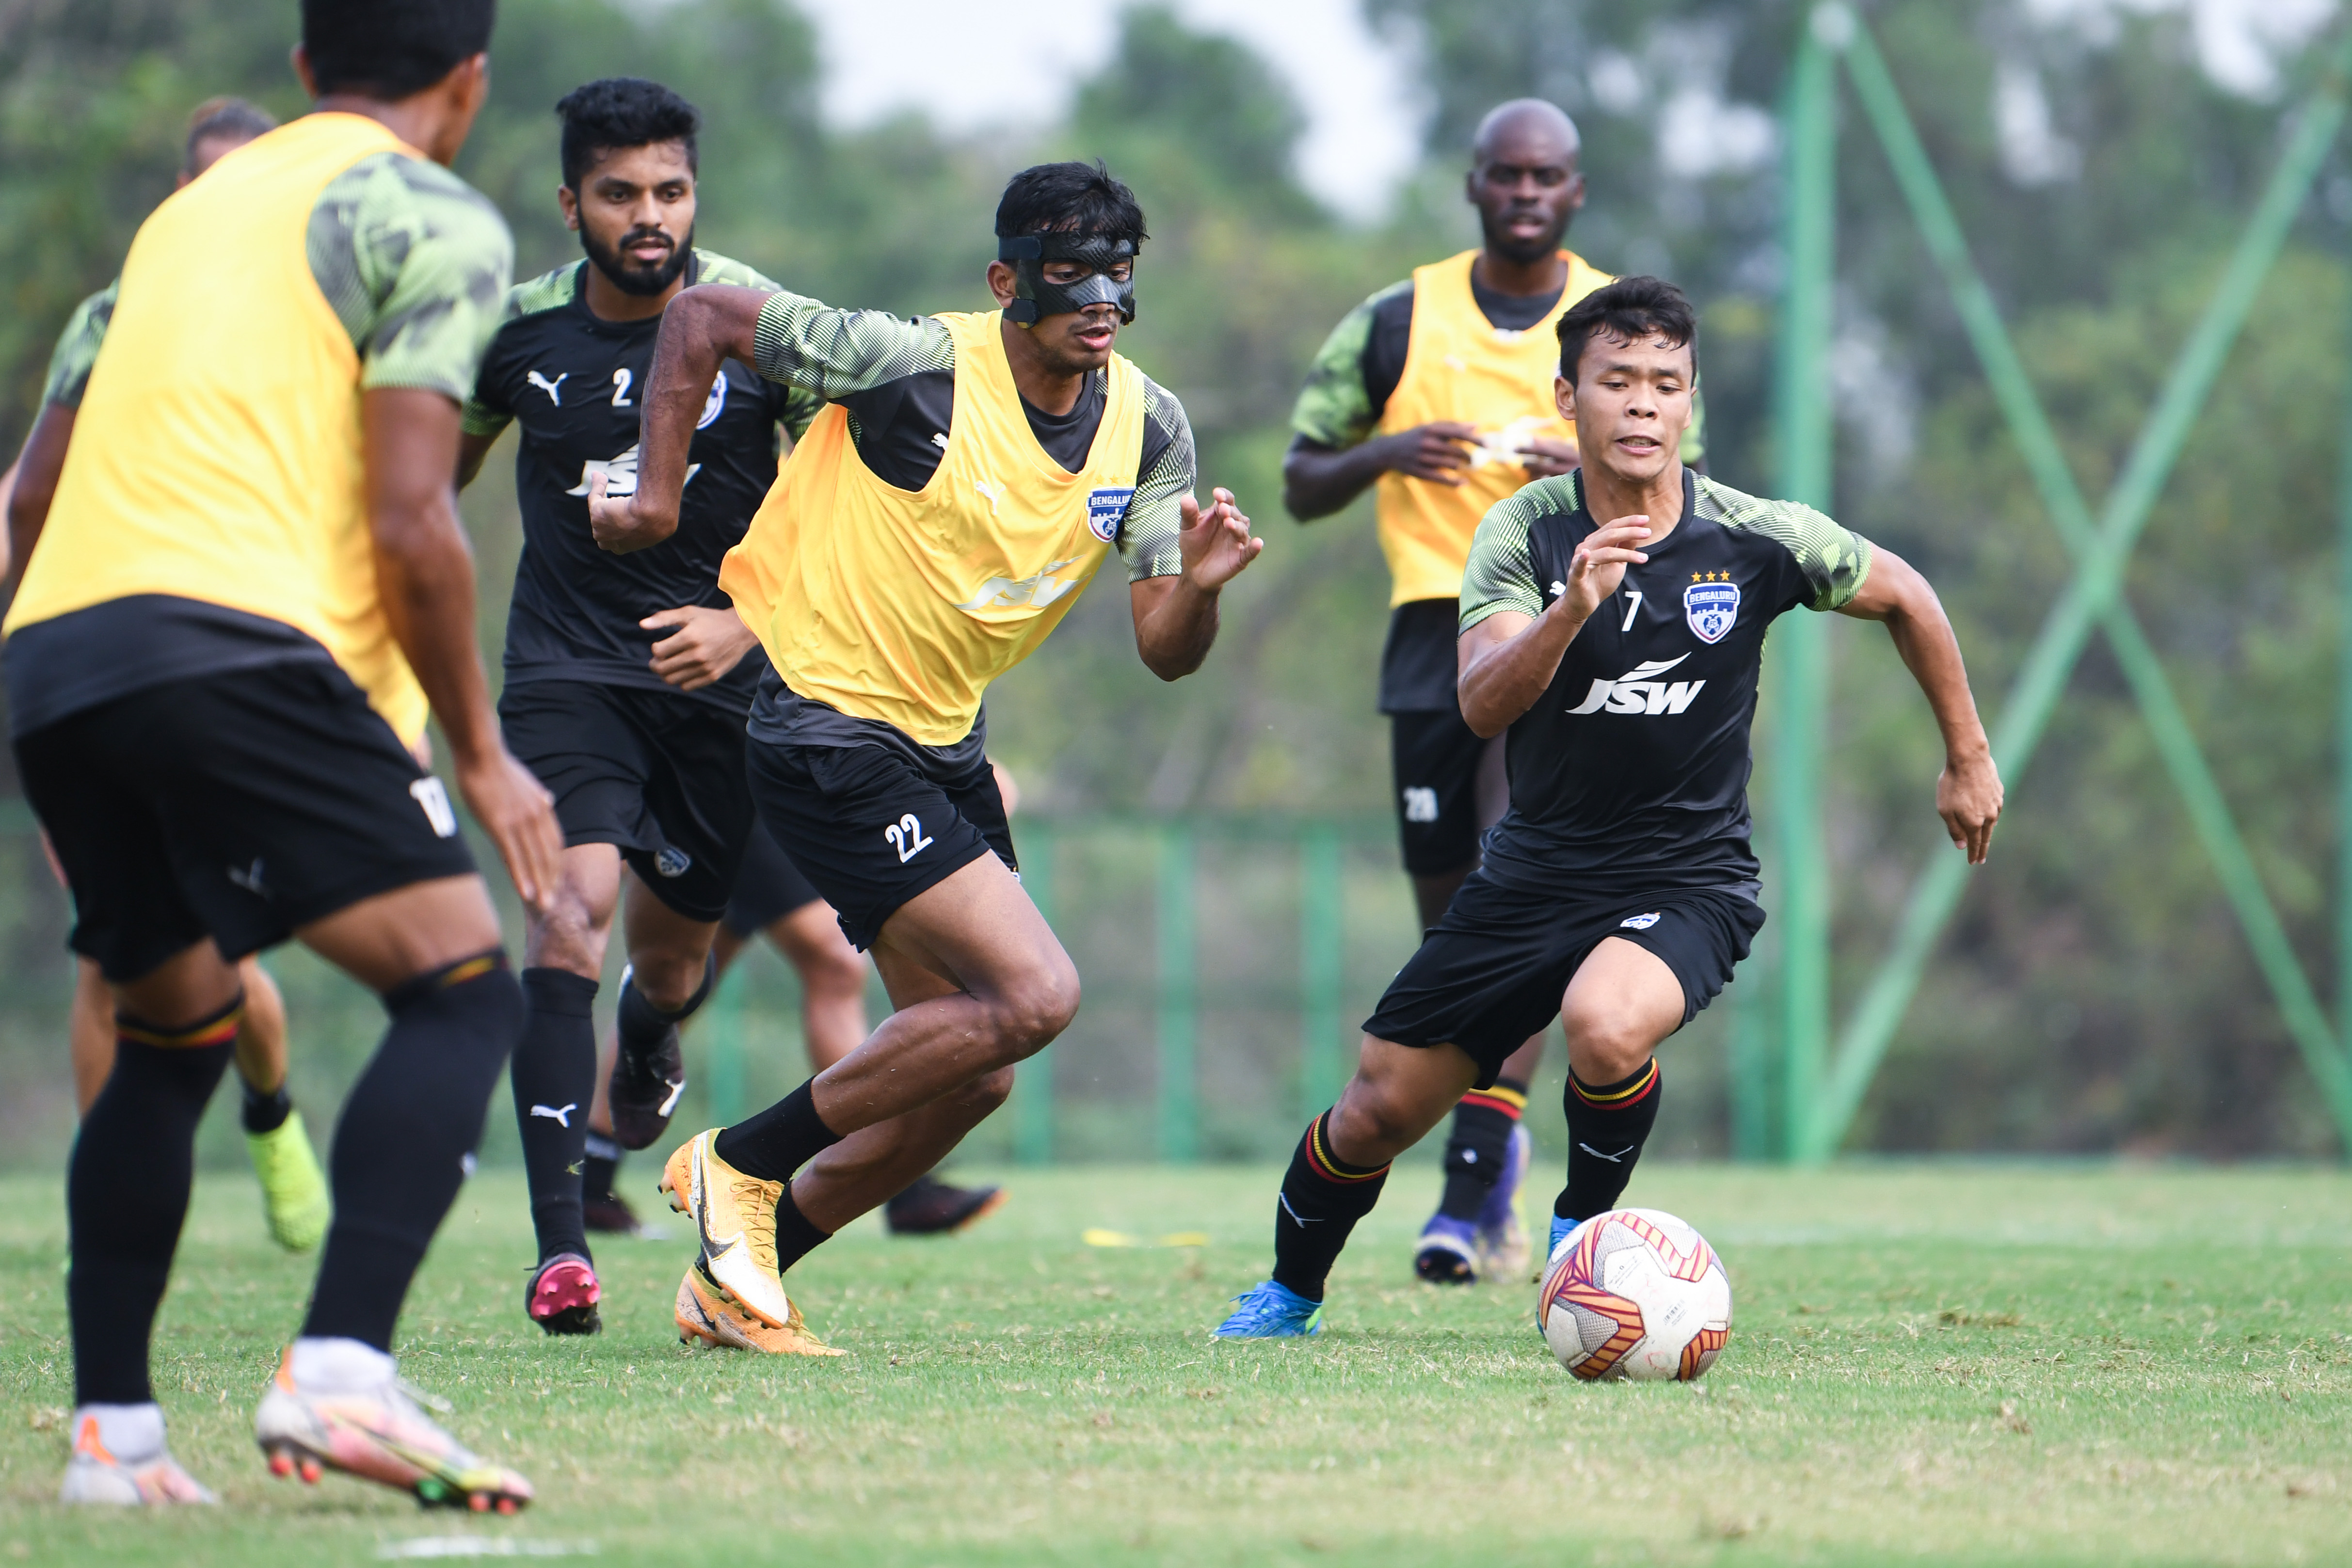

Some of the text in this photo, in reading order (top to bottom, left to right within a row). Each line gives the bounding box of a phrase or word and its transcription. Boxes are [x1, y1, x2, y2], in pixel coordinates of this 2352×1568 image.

[612, 368, 632, 407] 2
[1621, 591, 1643, 632] 7
[1689, 591, 1736, 603] BENGALURU
[1564, 678, 1707, 715] JSW
[884, 814, 934, 864] 22
